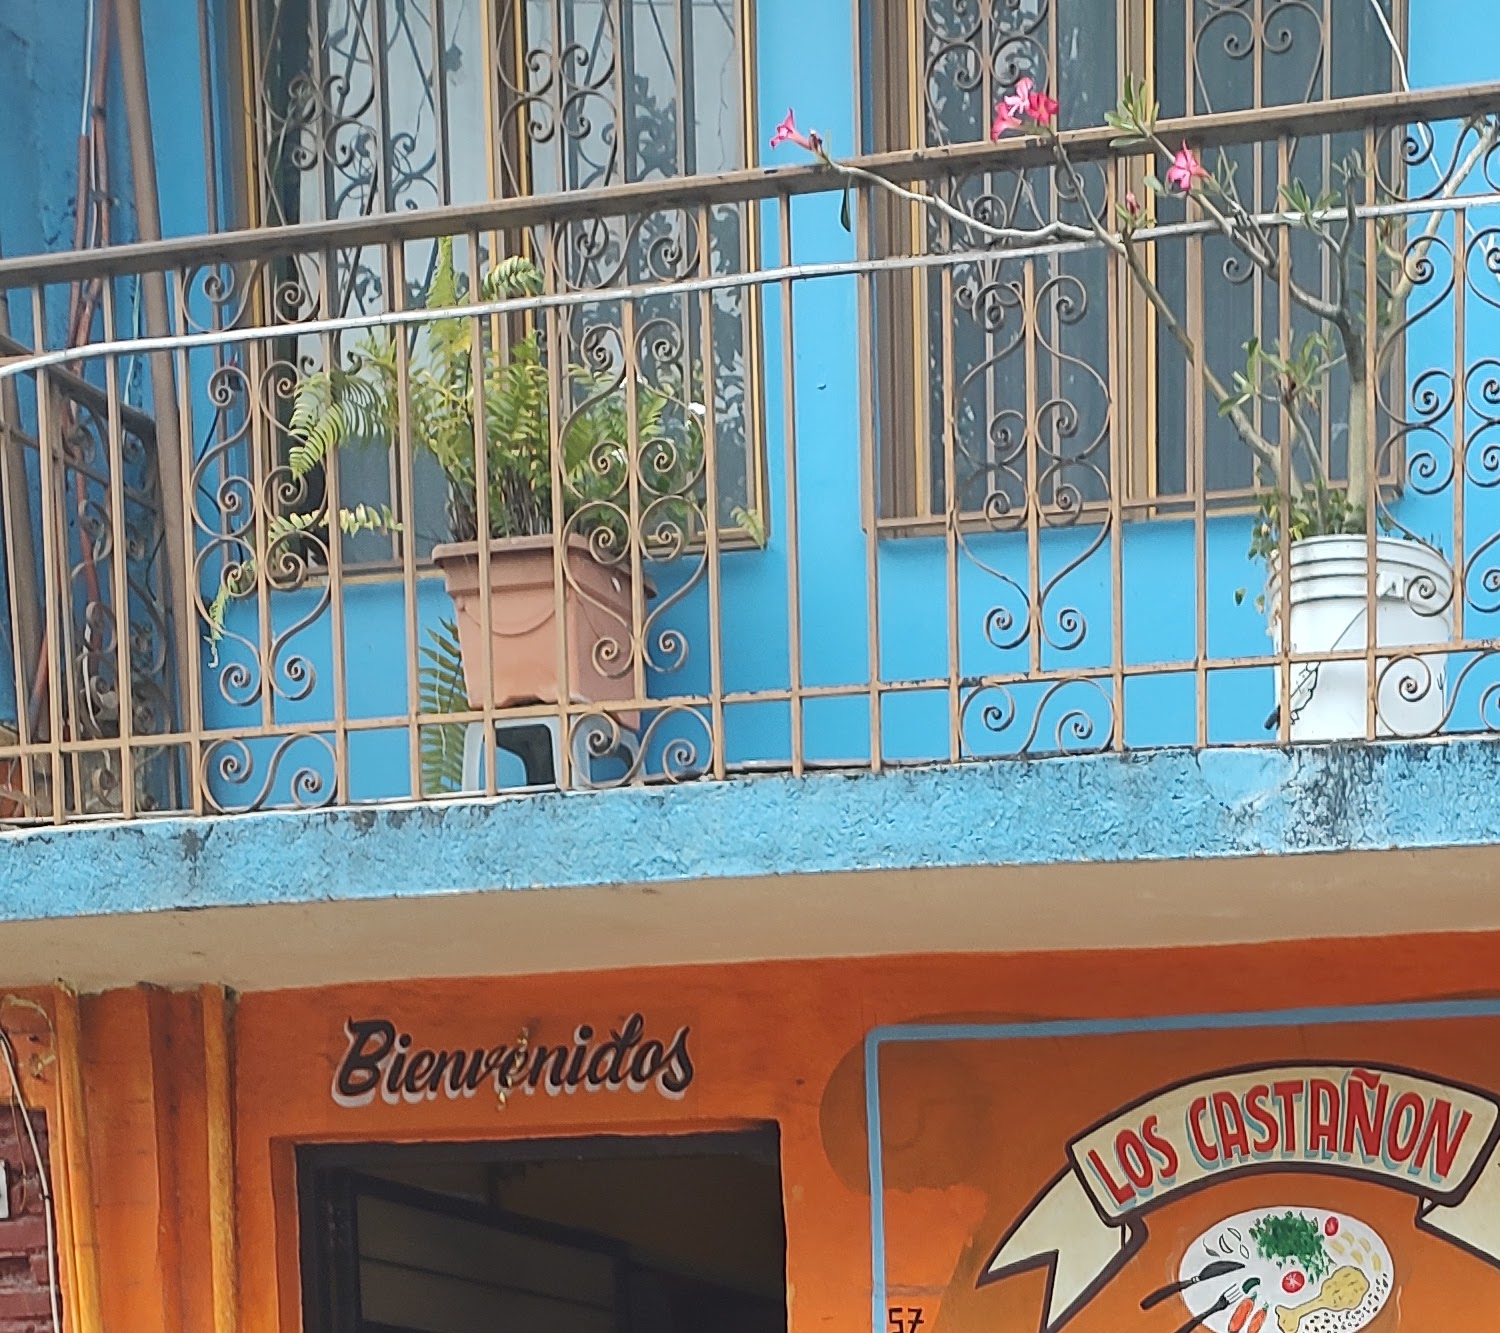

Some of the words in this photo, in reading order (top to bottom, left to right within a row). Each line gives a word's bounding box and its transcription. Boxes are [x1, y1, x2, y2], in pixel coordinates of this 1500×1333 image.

[332, 1013, 696, 1109] Bienvenidos
[1088, 1114, 1180, 1209] LOS
[1187, 1069, 1474, 1180] CASTAÑON
